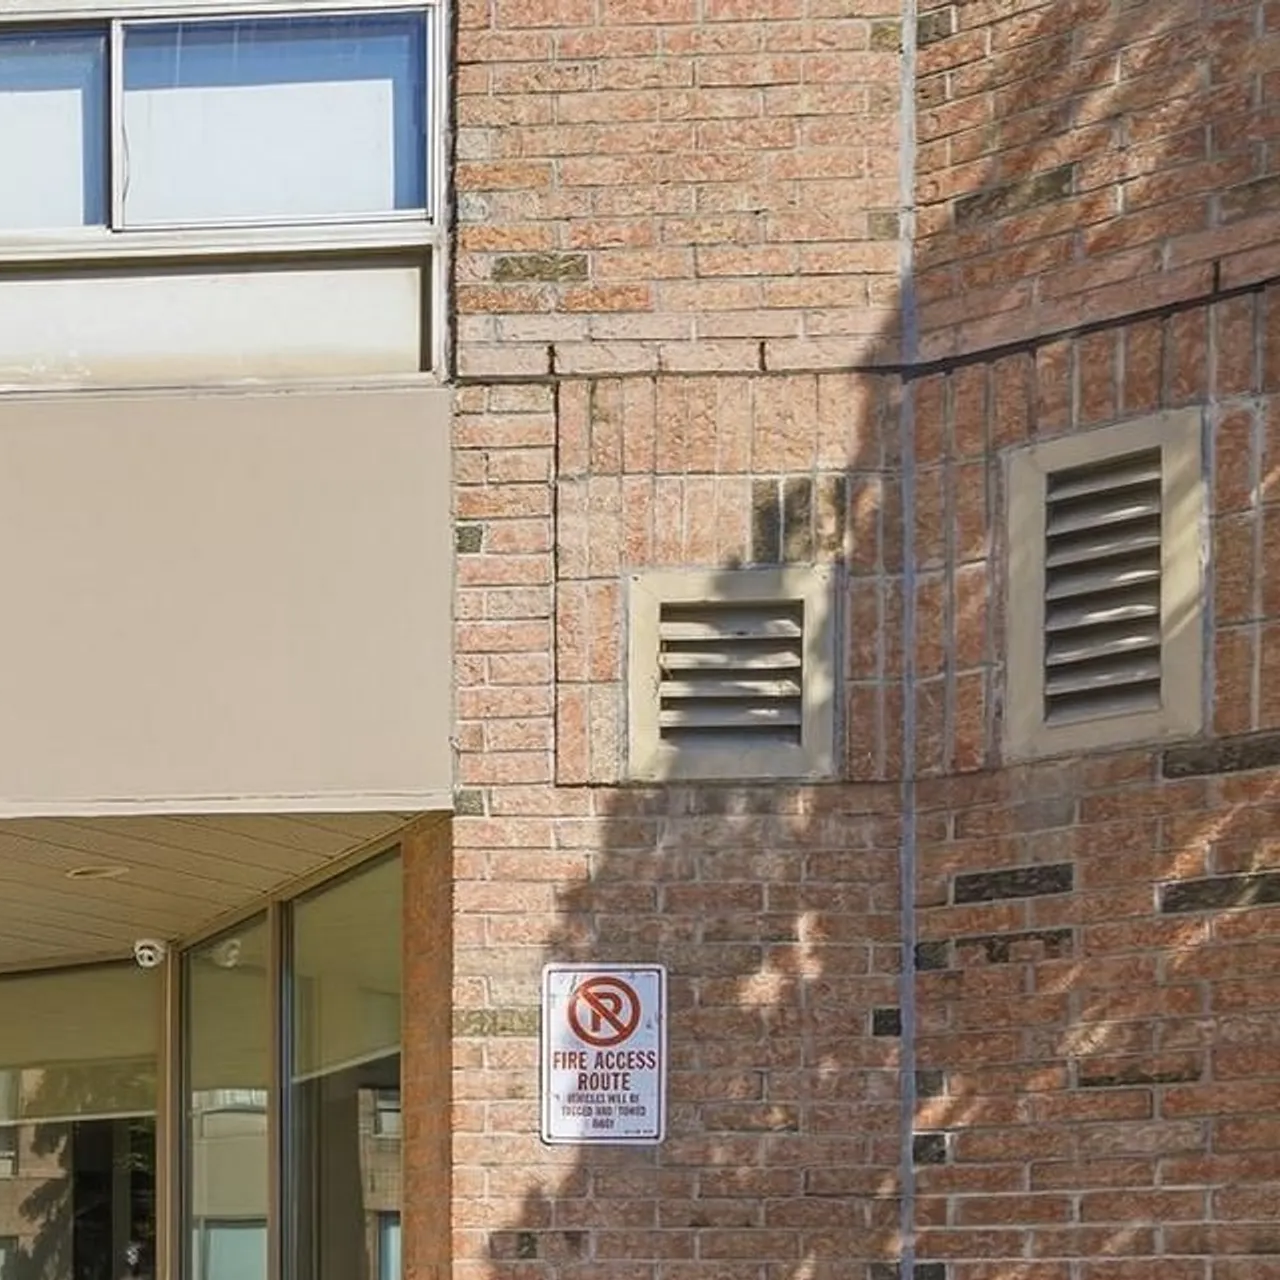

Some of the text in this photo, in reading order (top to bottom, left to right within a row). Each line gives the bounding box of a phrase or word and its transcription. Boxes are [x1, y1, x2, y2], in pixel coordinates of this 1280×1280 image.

[553, 1050, 656, 1070] FIRE ACCESS
[578, 1072, 631, 1091] ROUTE
